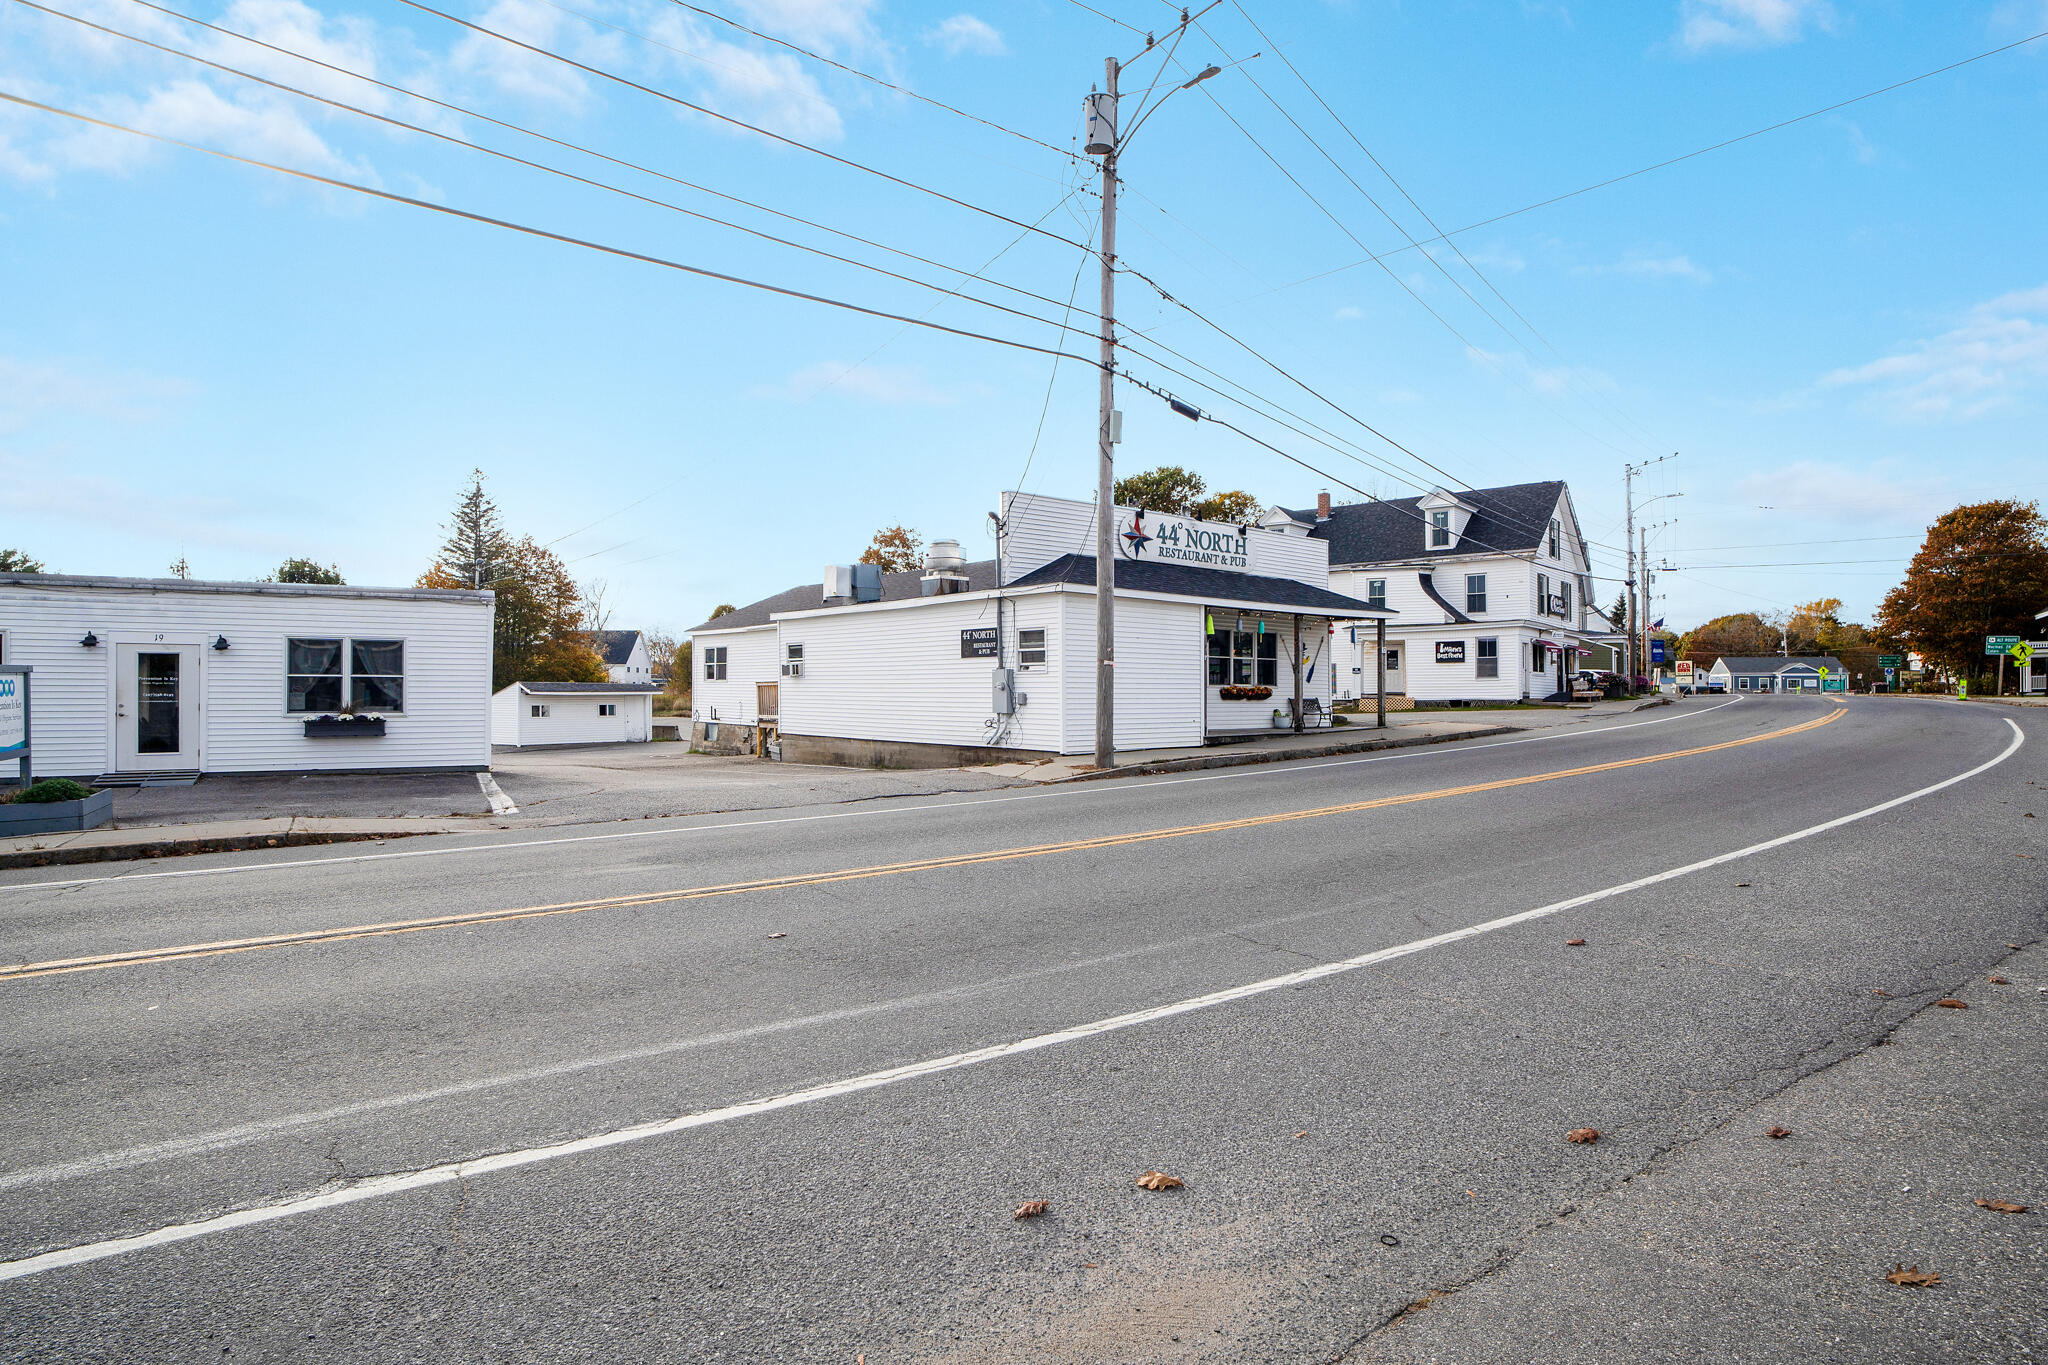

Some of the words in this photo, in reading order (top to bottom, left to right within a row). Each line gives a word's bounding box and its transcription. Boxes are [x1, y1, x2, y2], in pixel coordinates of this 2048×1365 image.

[1185, 528, 1248, 555] NORTH
[1158, 547, 1219, 565] RESTAURANT
[1221, 555, 1228, 565] &
[1229, 556, 1247, 567] PUB
[154, 633, 164, 642] 19
[972, 630, 996, 640] NORTH
